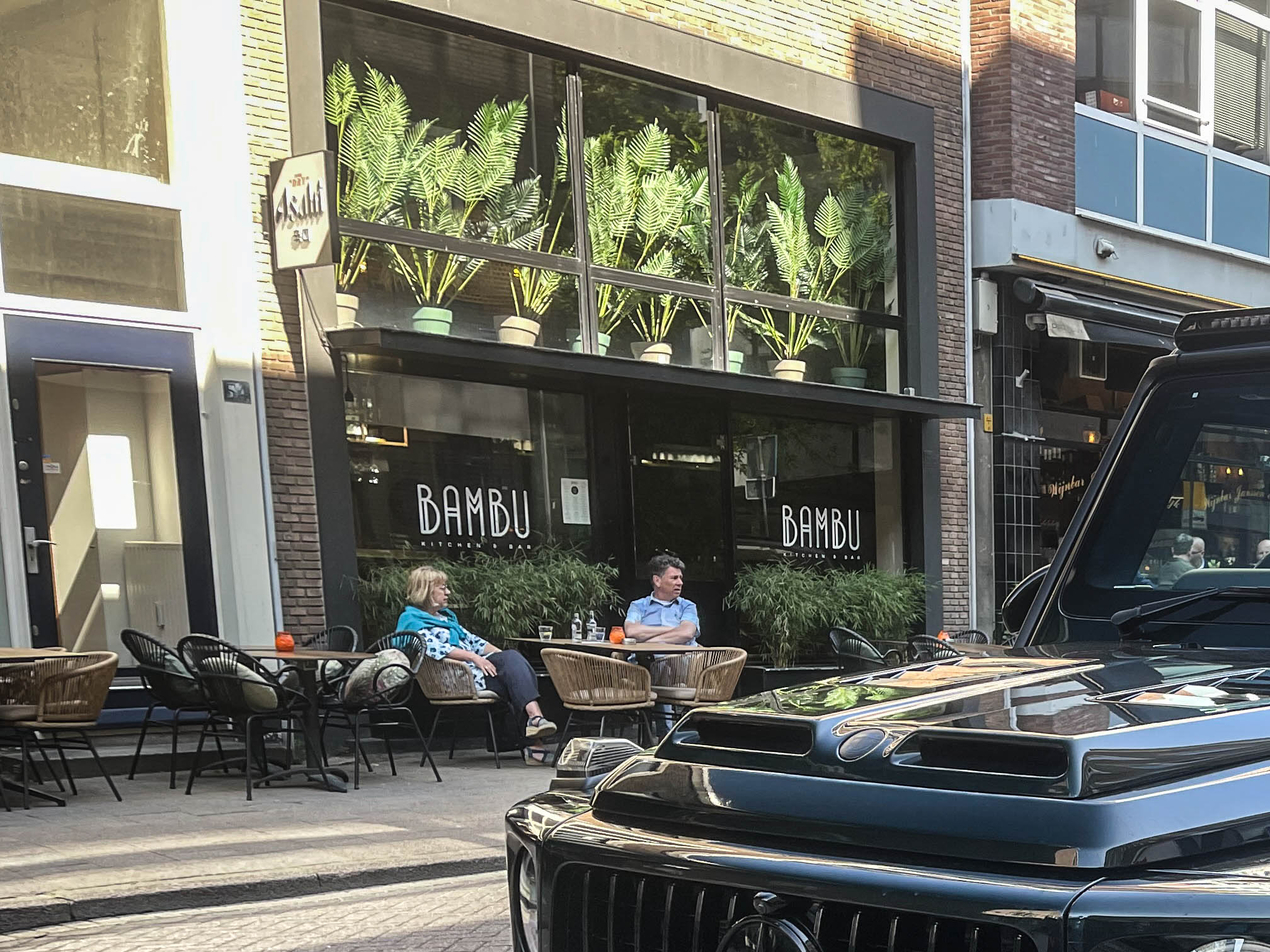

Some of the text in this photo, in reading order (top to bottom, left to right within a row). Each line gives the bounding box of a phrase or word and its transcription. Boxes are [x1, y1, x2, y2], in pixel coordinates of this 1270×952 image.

[275, 178, 324, 224] Asahi
[416, 483, 531, 539] BAMBU
[782, 505, 860, 551] BAMBU
[421, 541, 482, 549] KITCHEN
